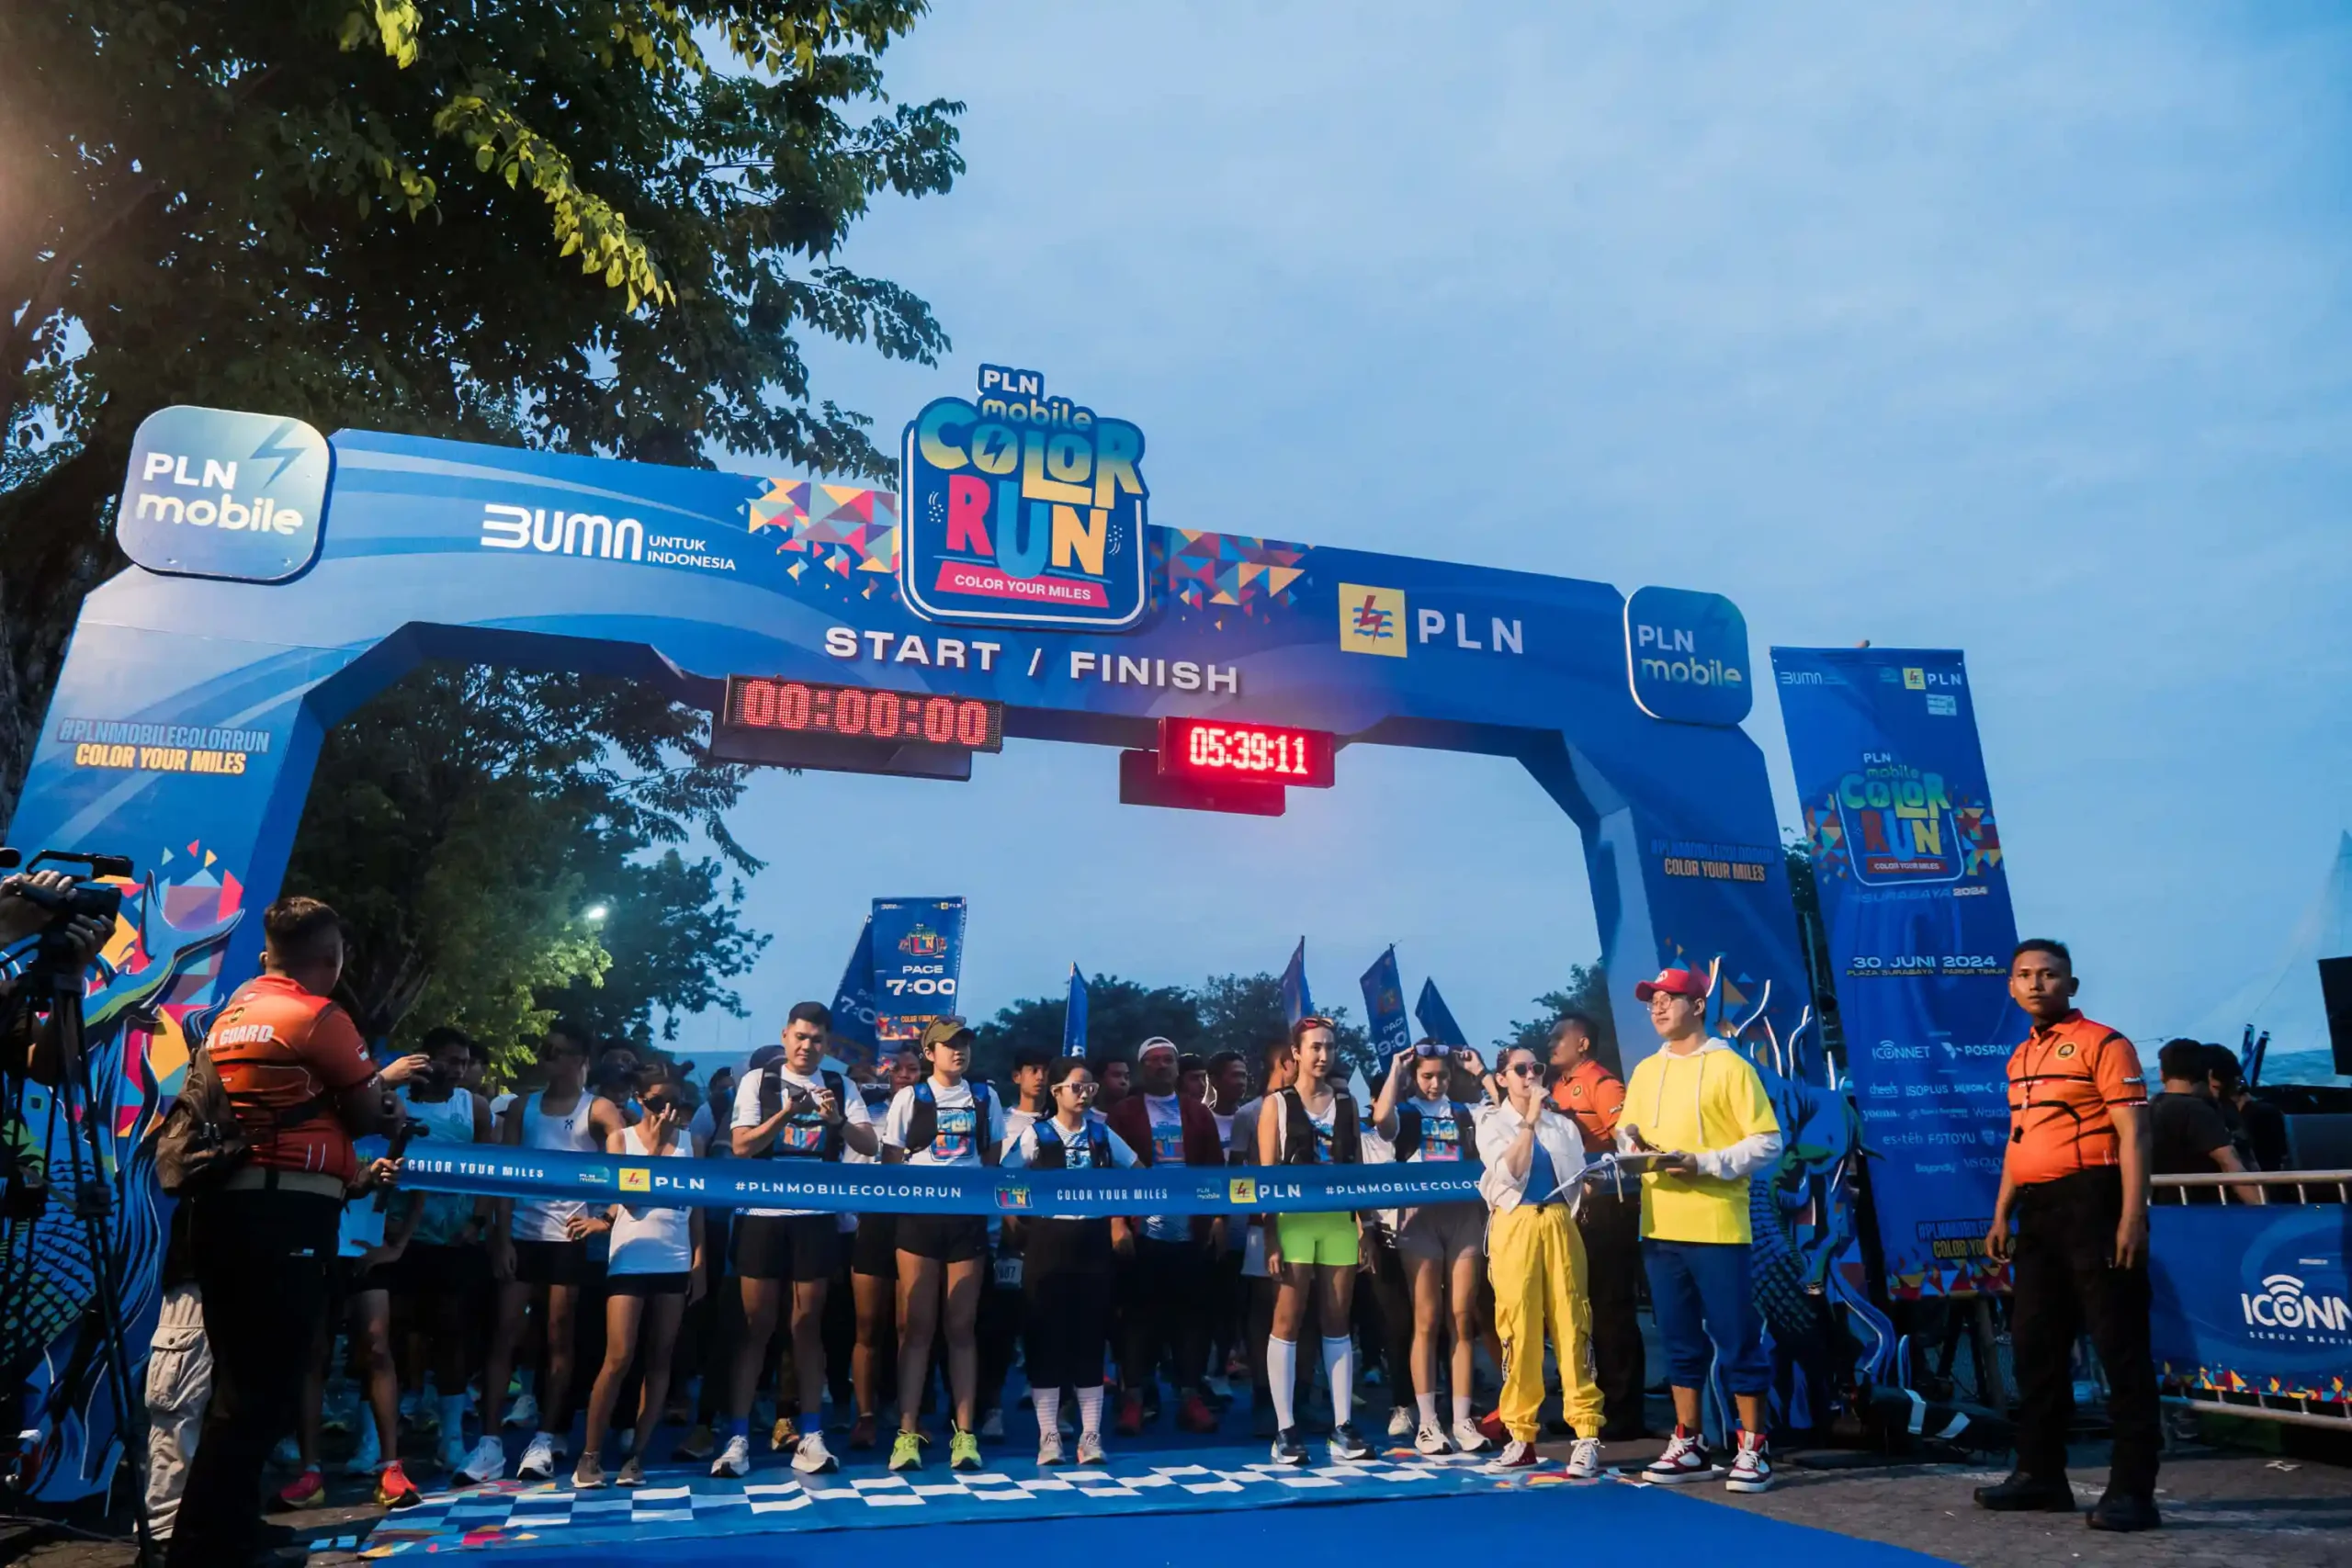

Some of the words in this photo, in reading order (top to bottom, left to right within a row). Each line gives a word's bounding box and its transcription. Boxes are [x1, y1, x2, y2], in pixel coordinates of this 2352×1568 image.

[983, 369, 1038, 395] PLN
[982, 399, 1092, 431] mobile
[919, 401, 1143, 509] COLOR
[142, 451, 238, 490] PLN
[135, 493, 304, 536] mobile
[945, 474, 1108, 580] RUN
[649, 535, 707, 552] UNTUK
[647, 550, 737, 571] INDONESIA
[954, 574, 1004, 591] COLOR
[1007, 581, 1046, 596] YOUR
[1047, 585, 1091, 601] MILES
[1418, 608, 1524, 654] PLN
[1637, 625, 1694, 653] PLN
[825, 626, 1001, 671] START
[1070, 650, 1238, 694] FINISH
[1640, 658, 1743, 689] mobile
[1927, 673, 1962, 686] PLN
[743, 680, 988, 746] 00:00:00
[59, 719, 270, 753] #PLNMOBILECOLORRUN
[75, 743, 136, 768] COLOR
[140, 747, 187, 772] YOUR
[190, 750, 247, 774] MILES
[1190, 727, 1308, 775] 05:39:11
[1863, 753, 1891, 764] PLN
[1839, 773, 1951, 819] COLOR
[1860, 810, 1941, 860] RUN
[1664, 857, 1700, 876] COLOR
[1702, 862, 1730, 879] YOUR
[1733, 863, 1765, 882] MILES
[1952, 886, 1988, 897] 2024
[902, 964, 944, 975] PACE
[1853, 956, 1882, 969] 30
[1890, 956, 1936, 968] JUNI
[1942, 955, 1996, 967] 2024
[886, 978, 956, 996] 7:00
[220, 1024, 275, 1045] GUARD
[1871, 1046, 1930, 1059] ICONNET
[1964, 1044, 2011, 1056] POSPAY
[408, 1159, 452, 1173] COLOR
[460, 1163, 494, 1176] YOUR
[503, 1167, 544, 1178] MILES
[655, 1176, 705, 1190] PLN
[735, 1181, 962, 1198] #PLNMOBILECOLORRUN
[1057, 1189, 1092, 1200] COLOR
[1099, 1190, 1127, 1200] YOUR
[1134, 1189, 1168, 1200] MILES
[1259, 1184, 1301, 1199] PLN
[1933, 1240, 1967, 1258] COLOR
